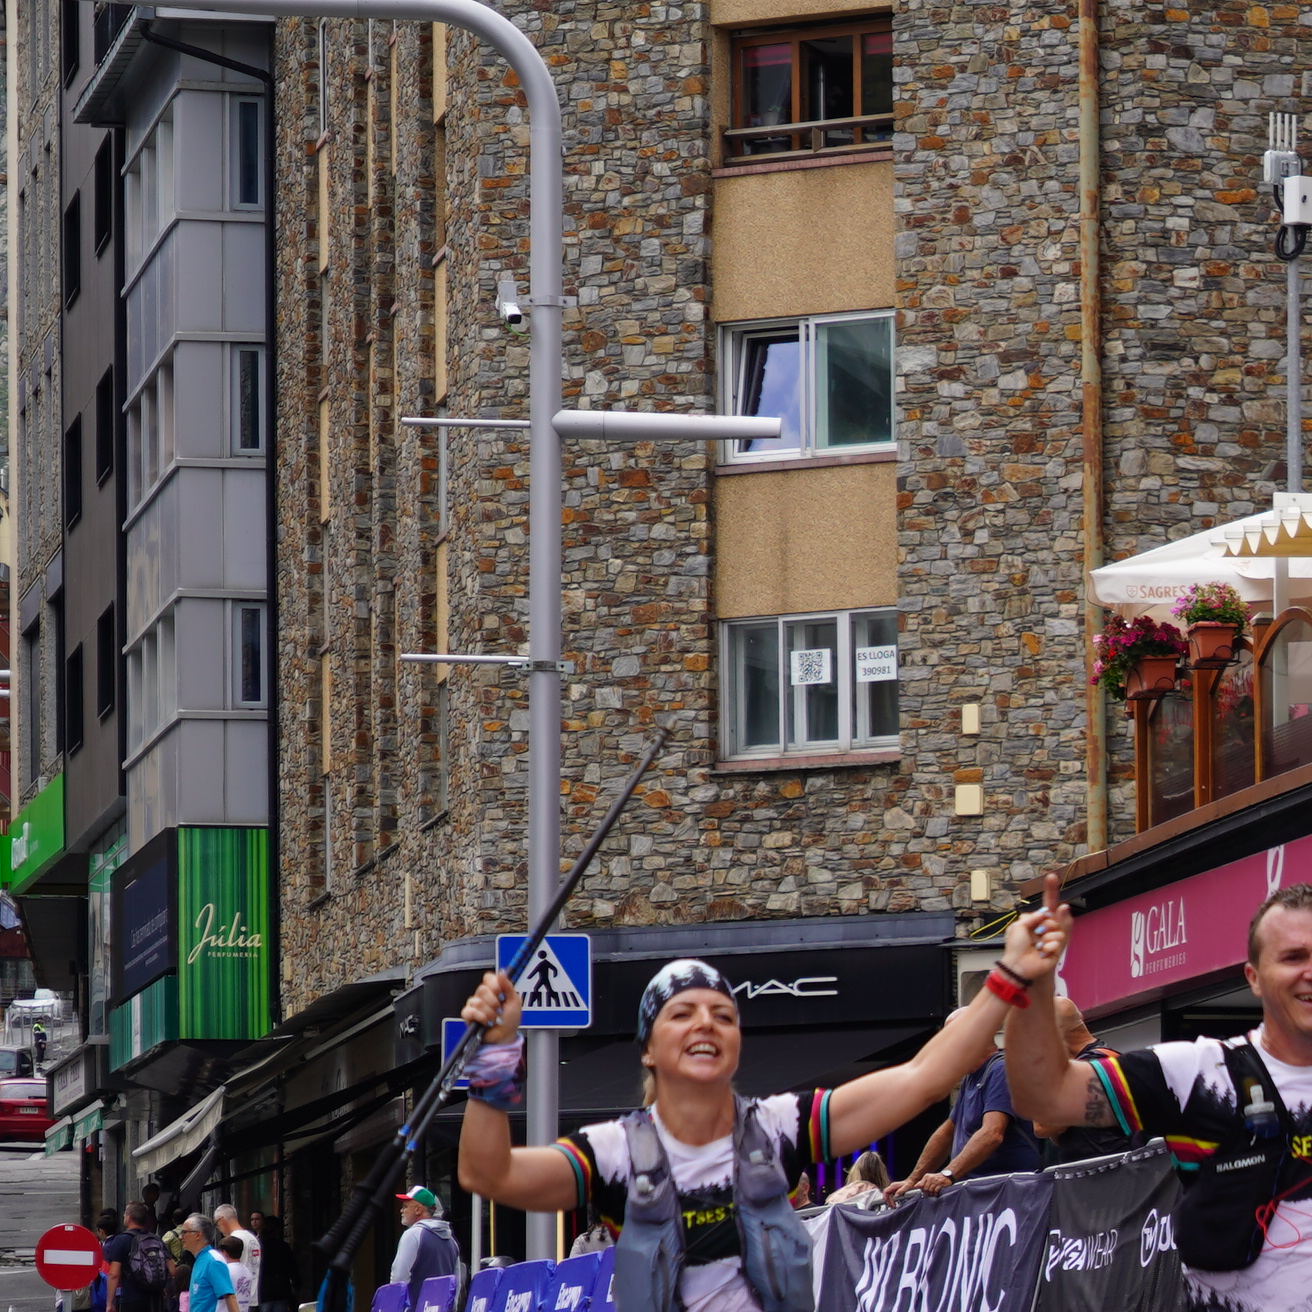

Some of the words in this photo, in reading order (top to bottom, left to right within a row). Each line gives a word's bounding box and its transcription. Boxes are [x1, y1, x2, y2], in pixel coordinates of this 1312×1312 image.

[1139, 584, 1188, 600] SAGRES
[857, 652, 868, 661] ES
[869, 649, 895, 660] LLOGA
[862, 665, 891, 676] 390981
[187, 903, 263, 965] Júlia
[1146, 896, 1187, 954] GALA
[1145, 951, 1186, 975] PERFUMERIES
[1216, 1154, 1266, 1173] SALOMON
